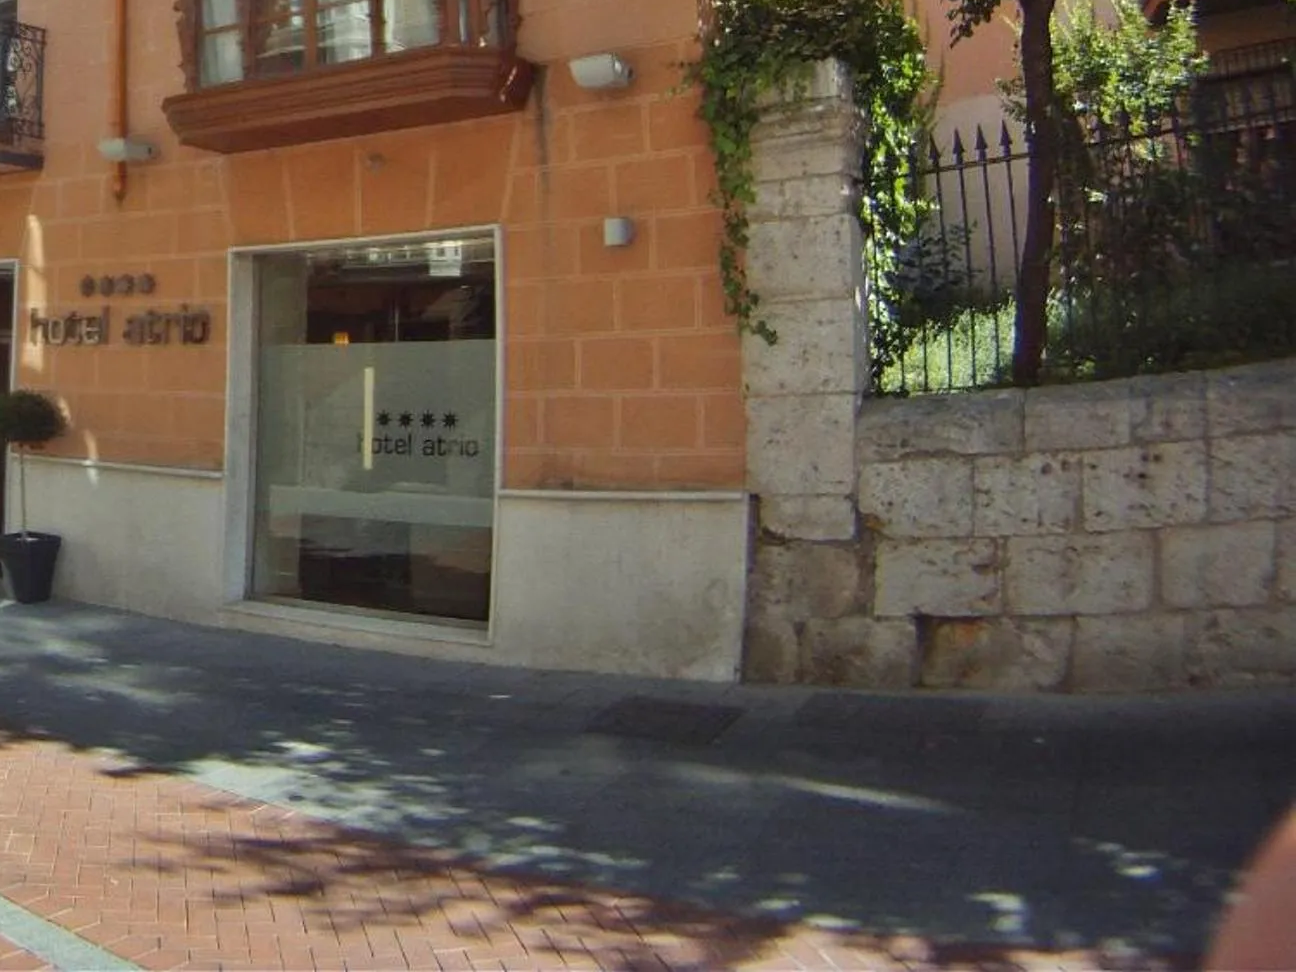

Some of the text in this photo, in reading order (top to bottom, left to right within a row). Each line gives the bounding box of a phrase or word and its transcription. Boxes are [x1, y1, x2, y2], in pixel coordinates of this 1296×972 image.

[29, 303, 212, 347] hotel atrio
[421, 434, 481, 458] atrio
